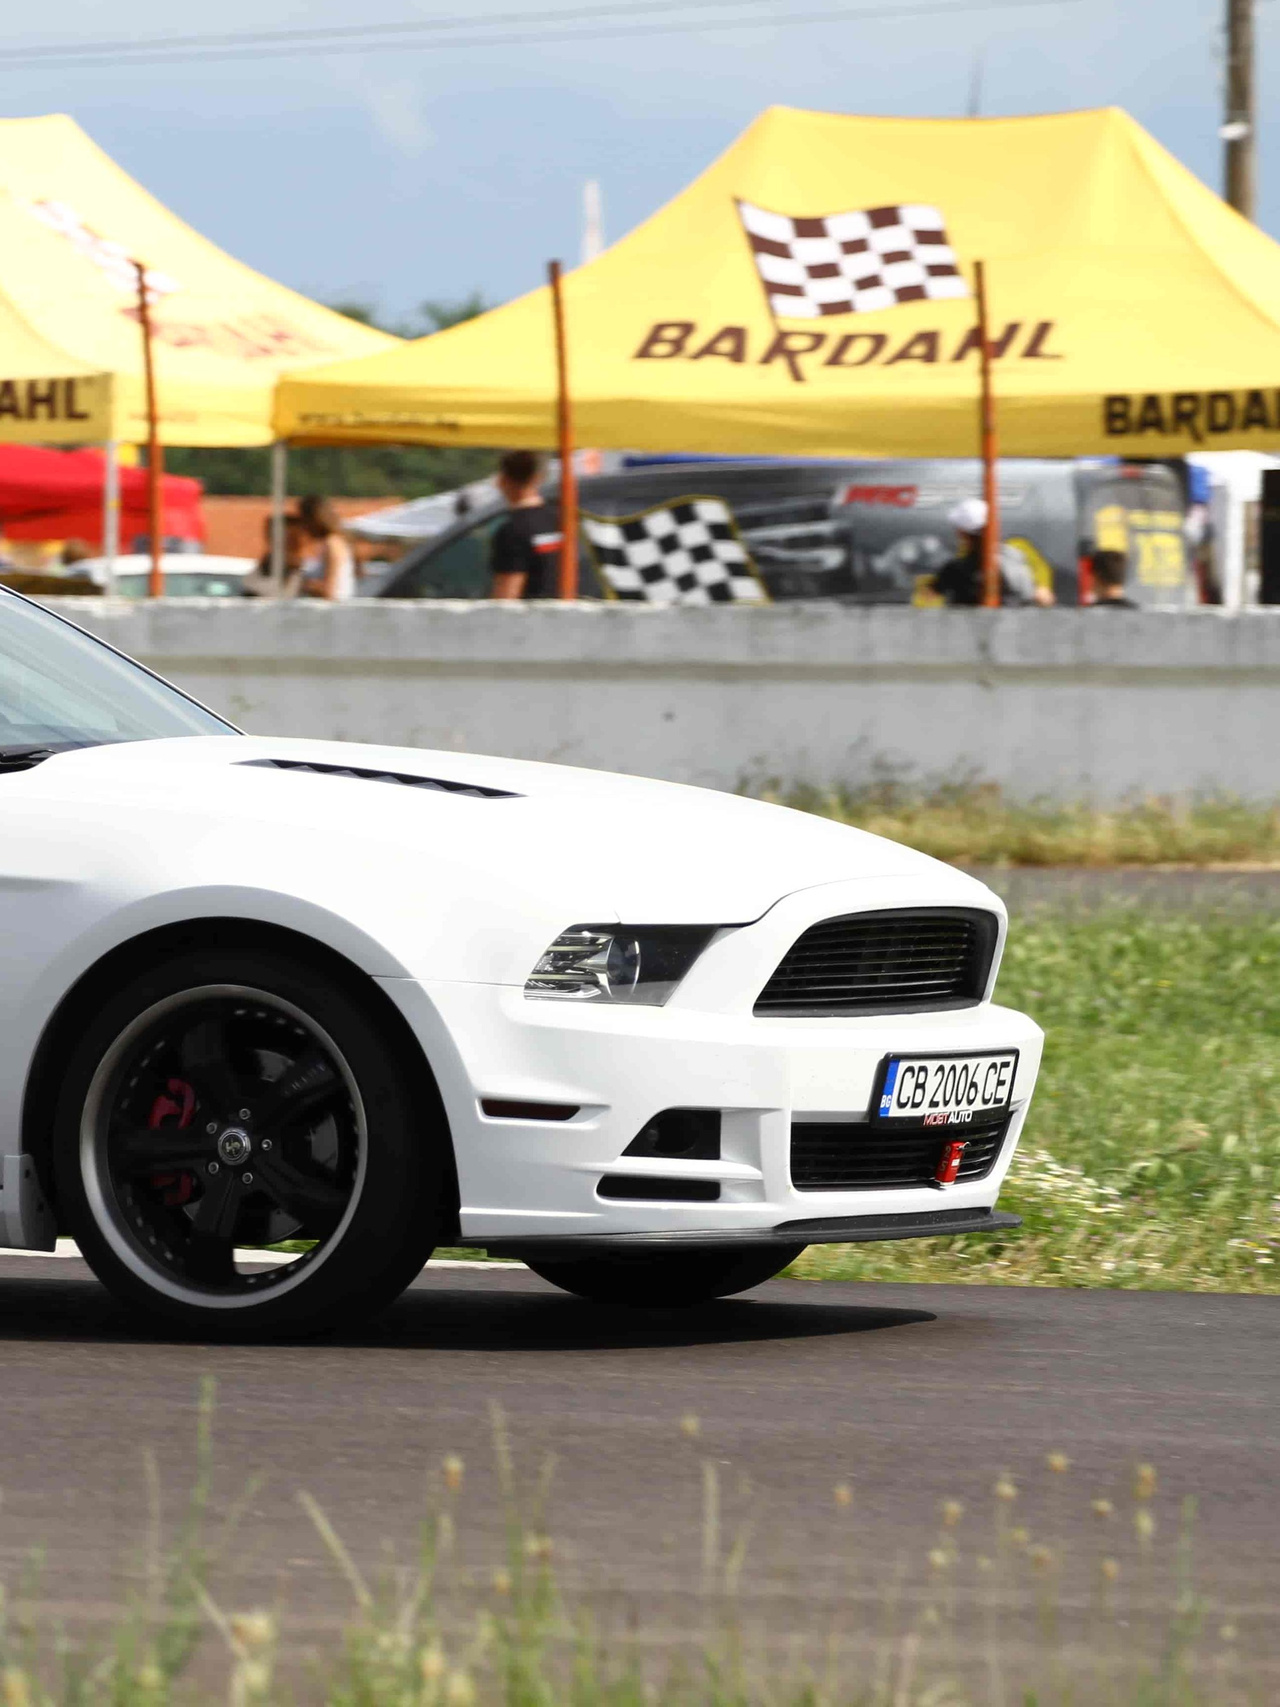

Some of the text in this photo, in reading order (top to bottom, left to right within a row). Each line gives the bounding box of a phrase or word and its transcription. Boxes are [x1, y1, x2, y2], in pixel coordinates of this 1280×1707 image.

[632, 320, 1064, 383] BARDAHL
[1105, 389, 1280, 444] BARDA
[880, 1094, 892, 1108] BG
[896, 1060, 1011, 1109] CB 2006 CE
